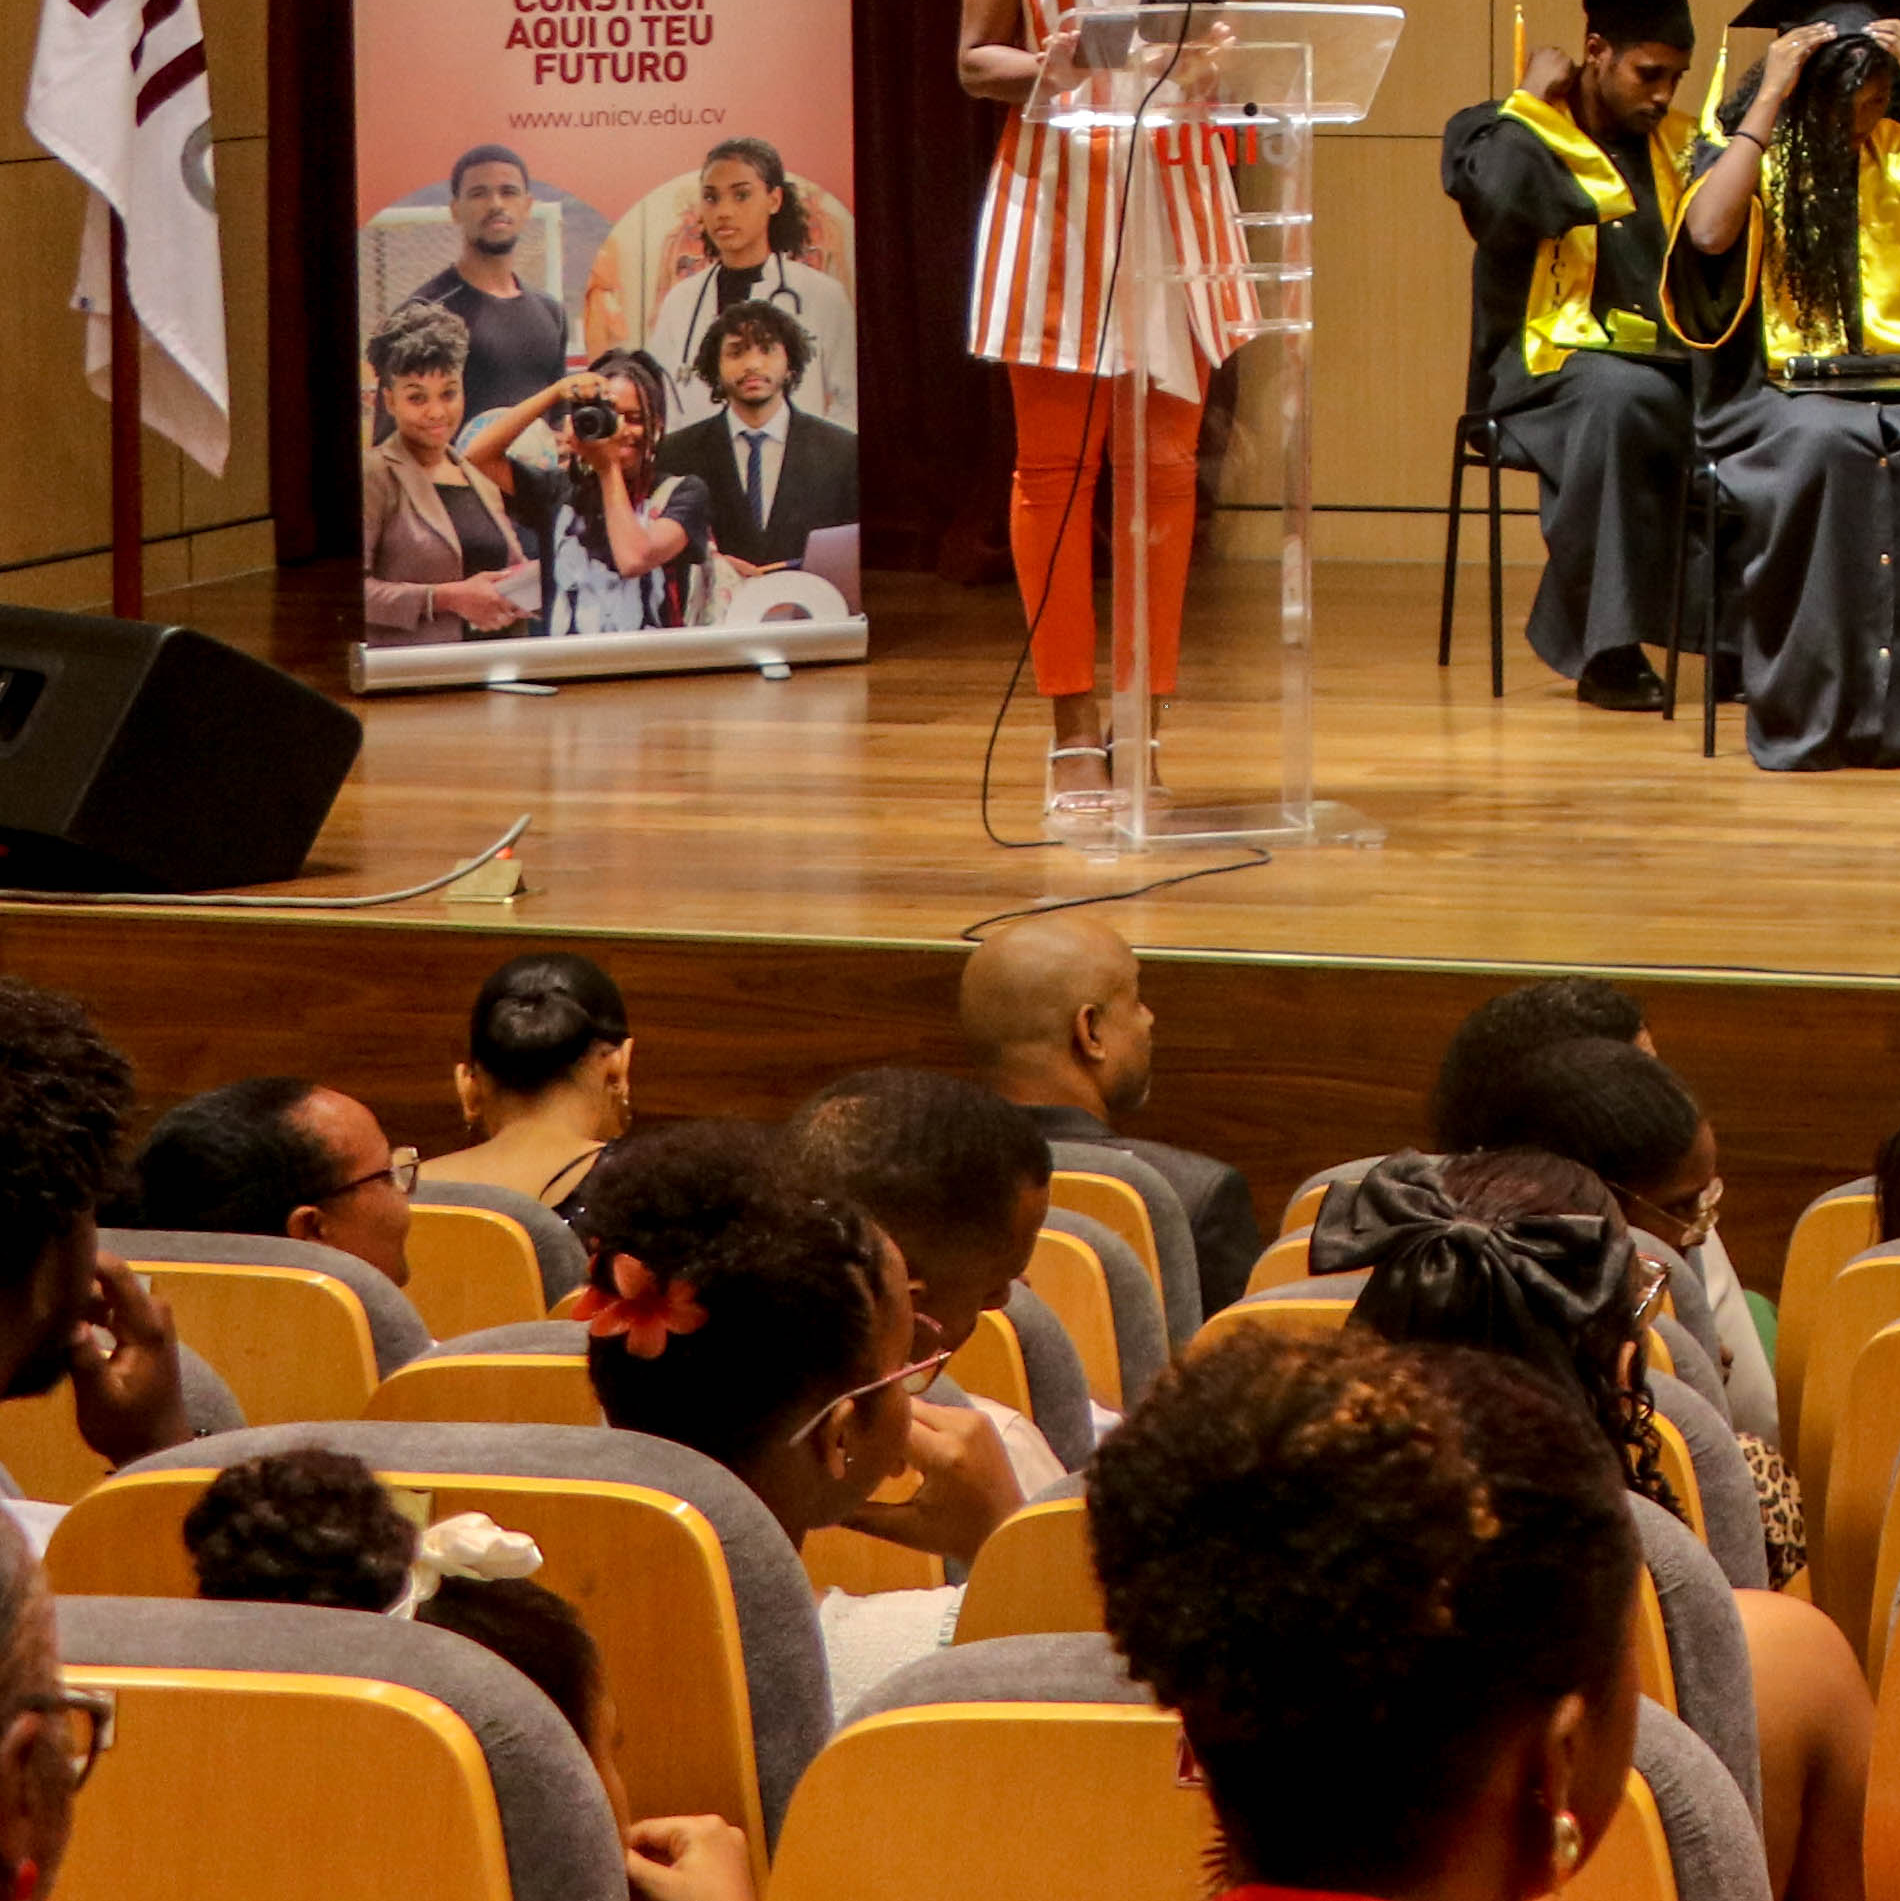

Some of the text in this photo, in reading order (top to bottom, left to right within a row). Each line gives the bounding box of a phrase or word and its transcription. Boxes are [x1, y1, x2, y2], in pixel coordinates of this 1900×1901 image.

[504, 14, 713, 49] AQUI O TEU
[534, 50, 688, 85] FUTURO
[507, 103, 727, 129] www.unicv.edu.cv
